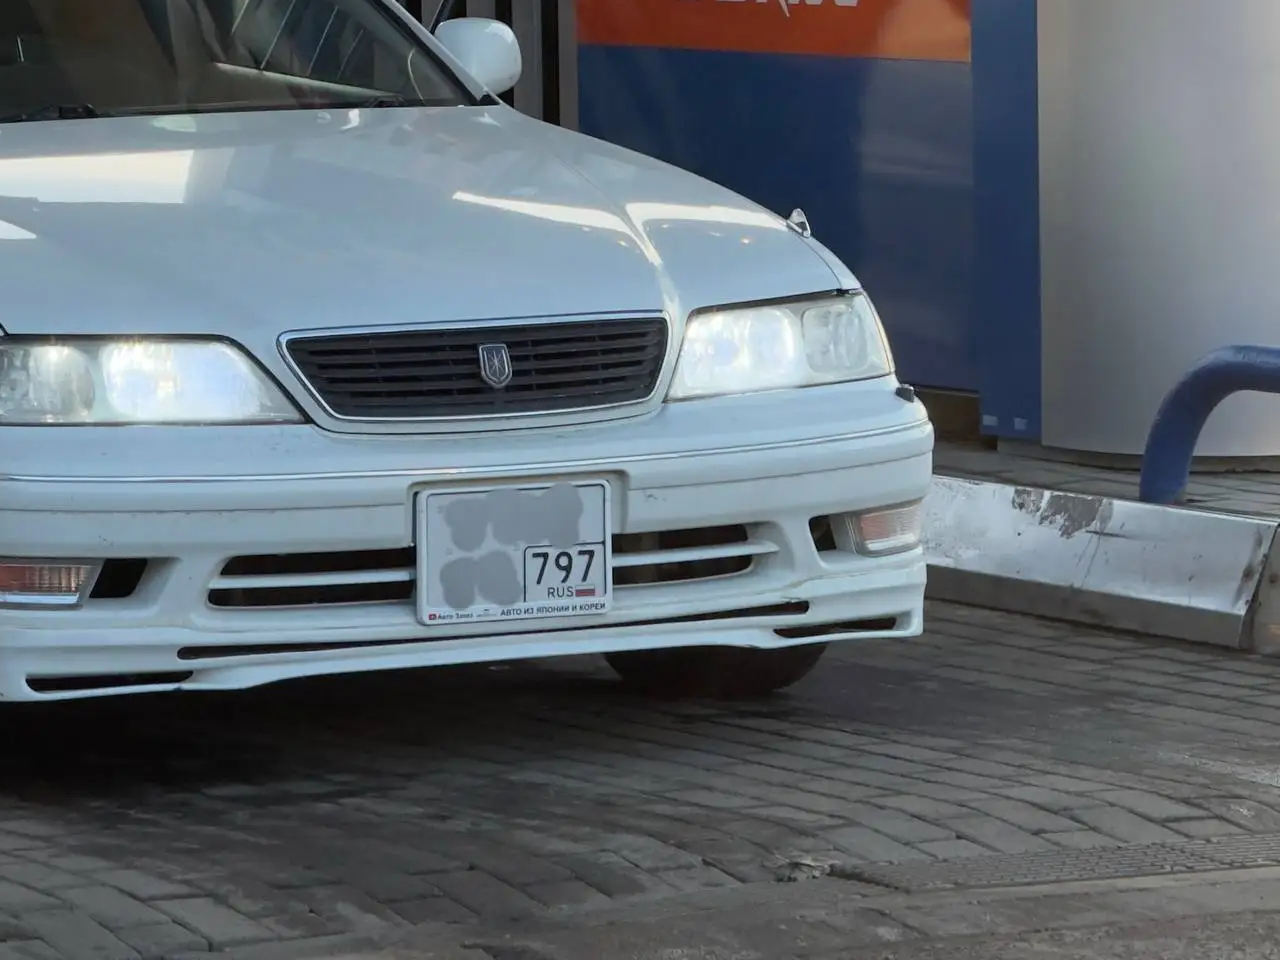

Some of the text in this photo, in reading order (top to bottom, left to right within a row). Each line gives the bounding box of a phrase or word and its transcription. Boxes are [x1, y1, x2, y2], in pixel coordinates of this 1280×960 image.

[531, 548, 596, 586] 797
[547, 586, 574, 599] RUS
[500, 608, 522, 617] АВТО
[523, 607, 534, 615] ИЗ
[536, 604, 570, 615] ЯПОНИИ
